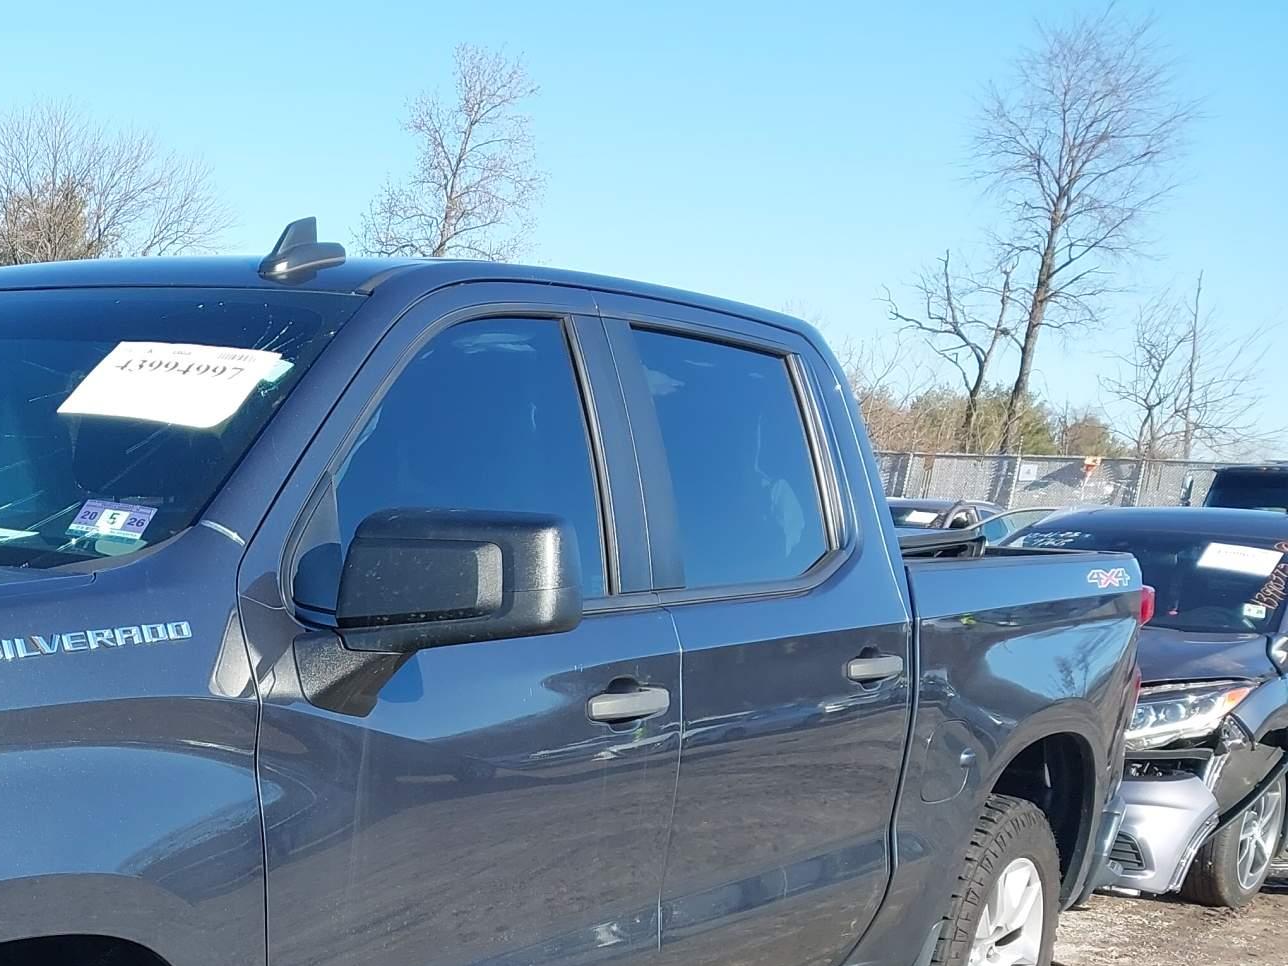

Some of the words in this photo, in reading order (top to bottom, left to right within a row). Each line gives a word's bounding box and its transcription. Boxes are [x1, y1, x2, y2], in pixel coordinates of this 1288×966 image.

[115, 358, 246, 381] 43994997
[80, 510, 99, 521] 20
[107, 511, 121, 526] 5
[126, 516, 147, 528] 26
